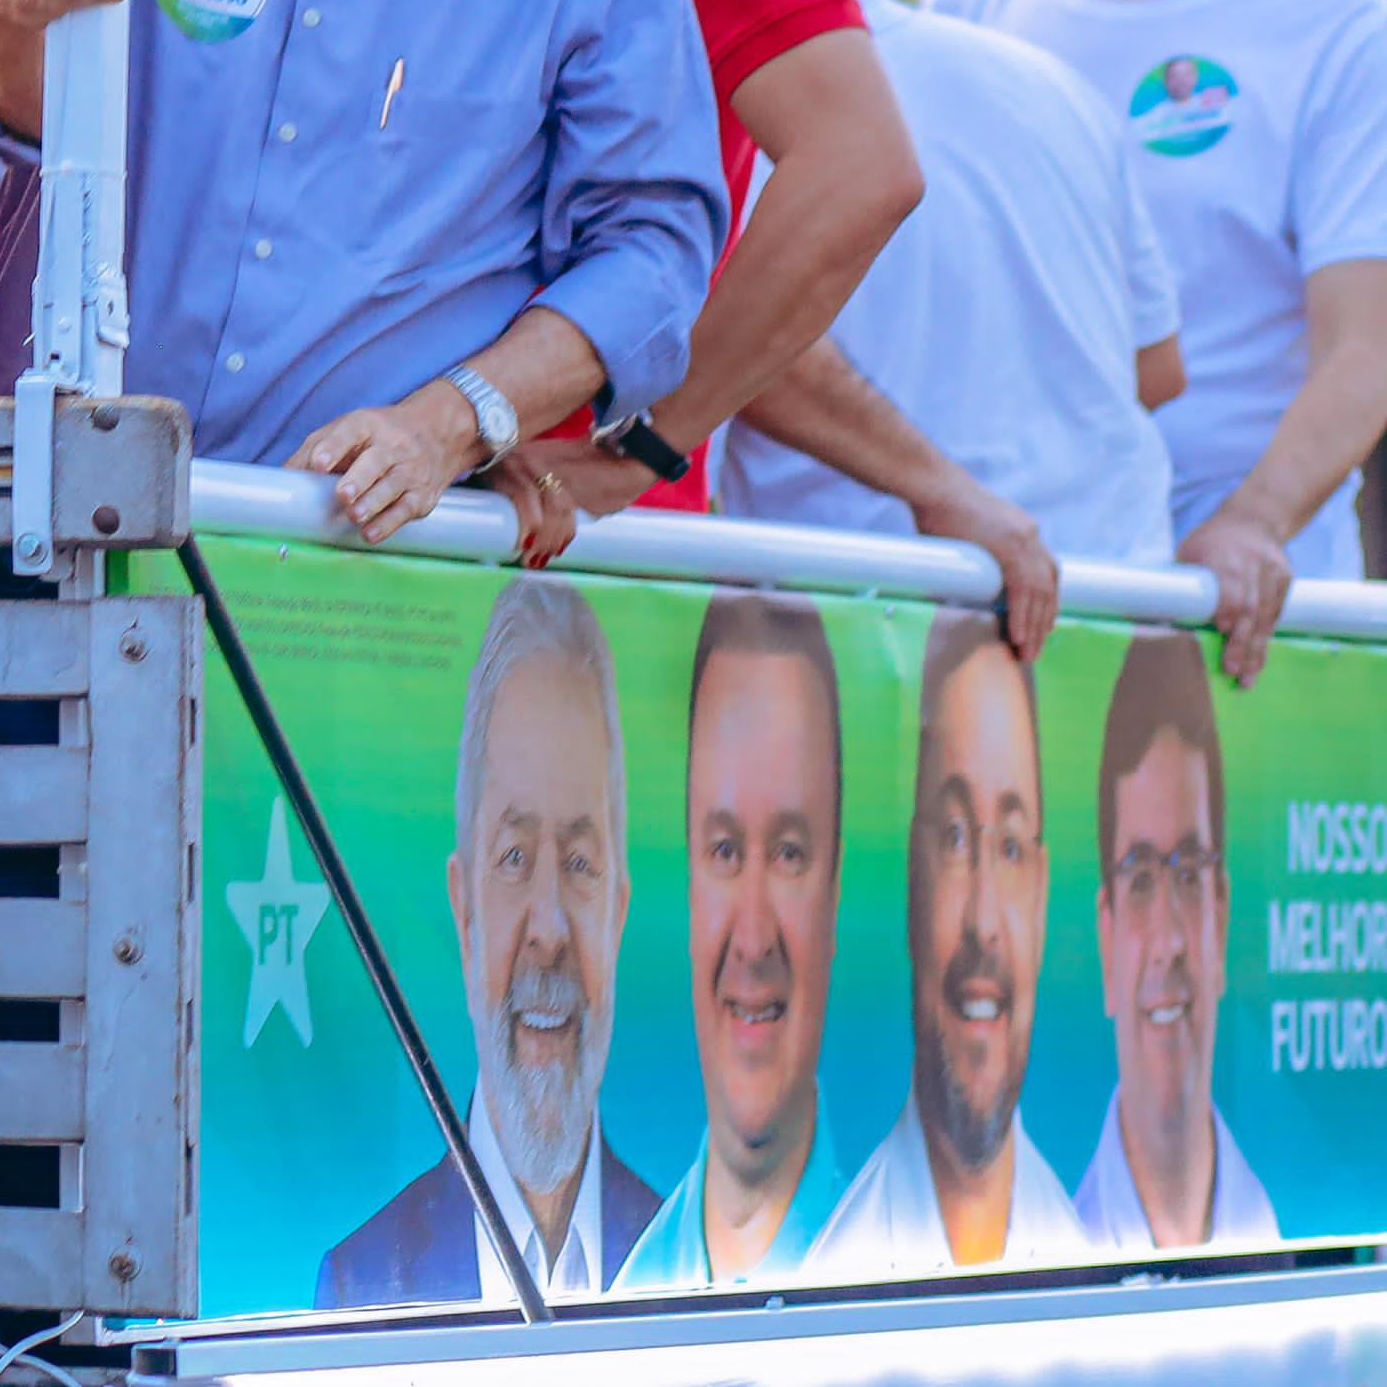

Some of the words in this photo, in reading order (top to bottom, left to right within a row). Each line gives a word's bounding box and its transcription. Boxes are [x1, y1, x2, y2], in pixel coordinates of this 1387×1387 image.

[1287, 800, 1387, 874] NOSSO
[258, 903, 299, 966] PT
[1269, 899, 1387, 973] MELHOR
[1271, 998, 1387, 1072] FUTURO
